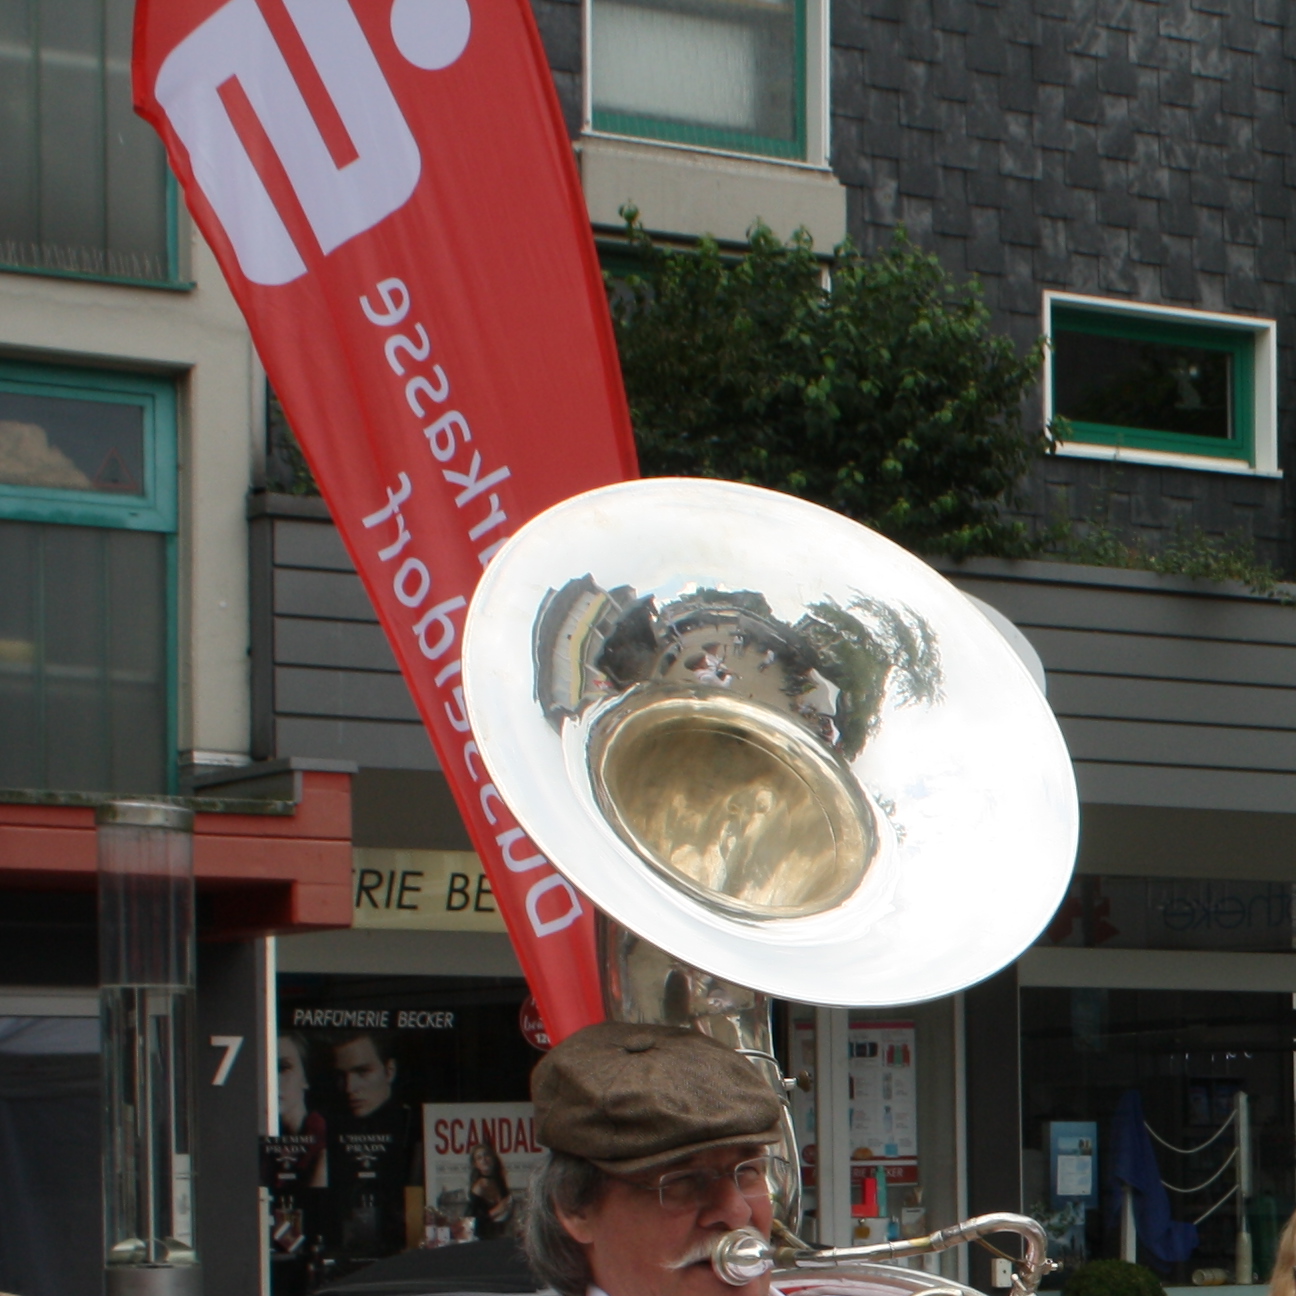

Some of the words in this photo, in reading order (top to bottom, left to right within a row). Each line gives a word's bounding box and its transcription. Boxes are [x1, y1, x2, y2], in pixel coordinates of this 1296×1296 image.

[354, 869, 424, 911] RIE
[447, 873, 502, 913] BE
[294, 1009, 390, 1029] PARFÜMERIE
[397, 1012, 454, 1029] BECKER
[210, 1036, 244, 1087] 7
[345, 1143, 387, 1153] PRADA
[434, 1117, 543, 1156] SCANDAL
